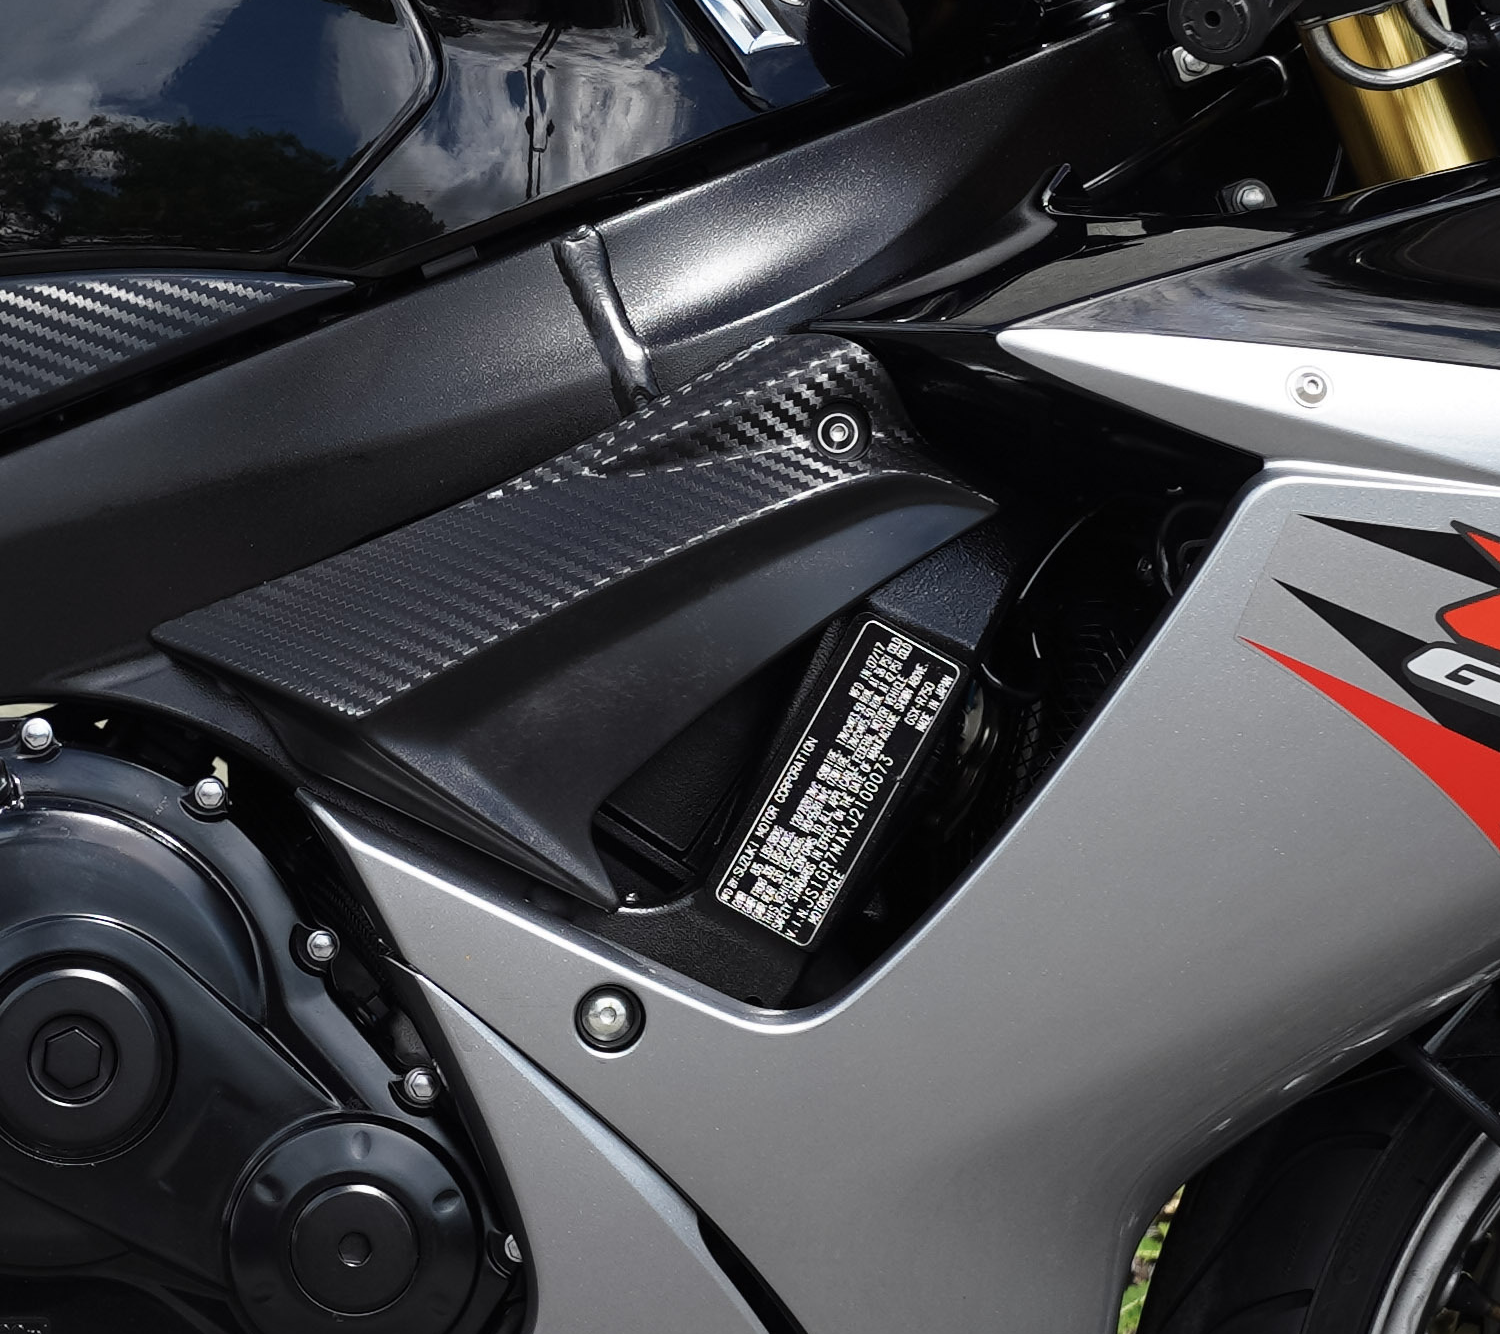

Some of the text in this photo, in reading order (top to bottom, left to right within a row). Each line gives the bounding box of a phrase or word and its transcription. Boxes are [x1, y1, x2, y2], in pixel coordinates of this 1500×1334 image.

[732, 840, 759, 878] SUZUKI
[754, 804, 780, 838] MOTOR
[773, 735, 818, 803] CORPORATION
[807, 869, 845, 925] MOTORCYCLE
[926, 698, 940, 711] IN
